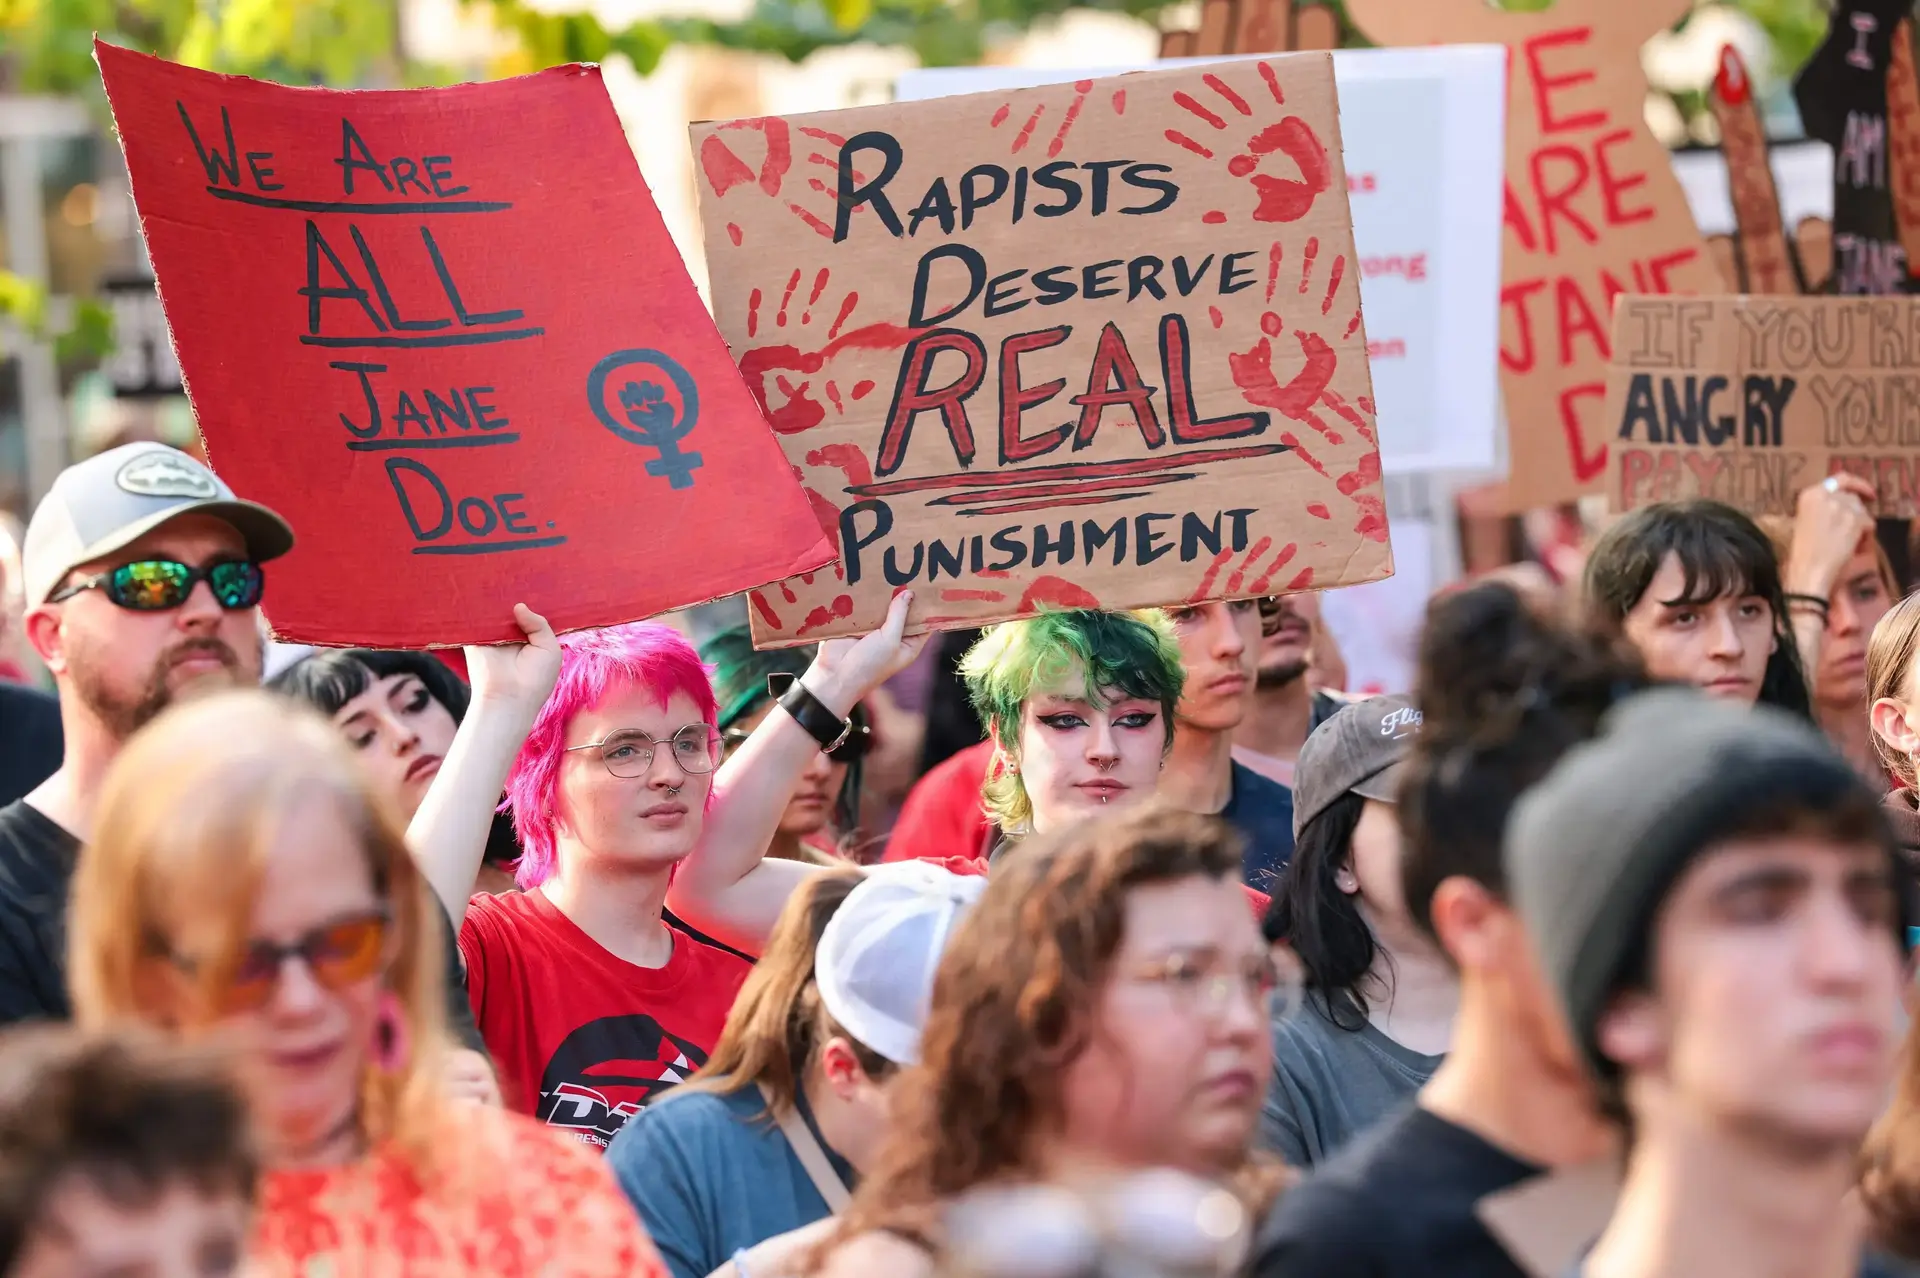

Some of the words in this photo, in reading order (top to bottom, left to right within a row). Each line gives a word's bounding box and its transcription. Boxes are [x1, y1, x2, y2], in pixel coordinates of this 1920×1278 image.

[1503, 27, 1608, 134] E
[1845, 11, 1878, 70] I
[176, 100, 285, 192] WE
[334, 117, 471, 197] ARE
[832, 131, 1180, 243] RAPISTS
[298, 218, 525, 334] ALL
[907, 242, 1260, 329] DESERVE
[1629, 301, 1713, 368] IF
[328, 359, 511, 439] JANE
[873, 312, 1273, 478] REAL
[1618, 373, 1797, 447] ANGRY
[838, 500, 1260, 589] PUNISHMENT
[573, 1132, 612, 1149] RESIS
